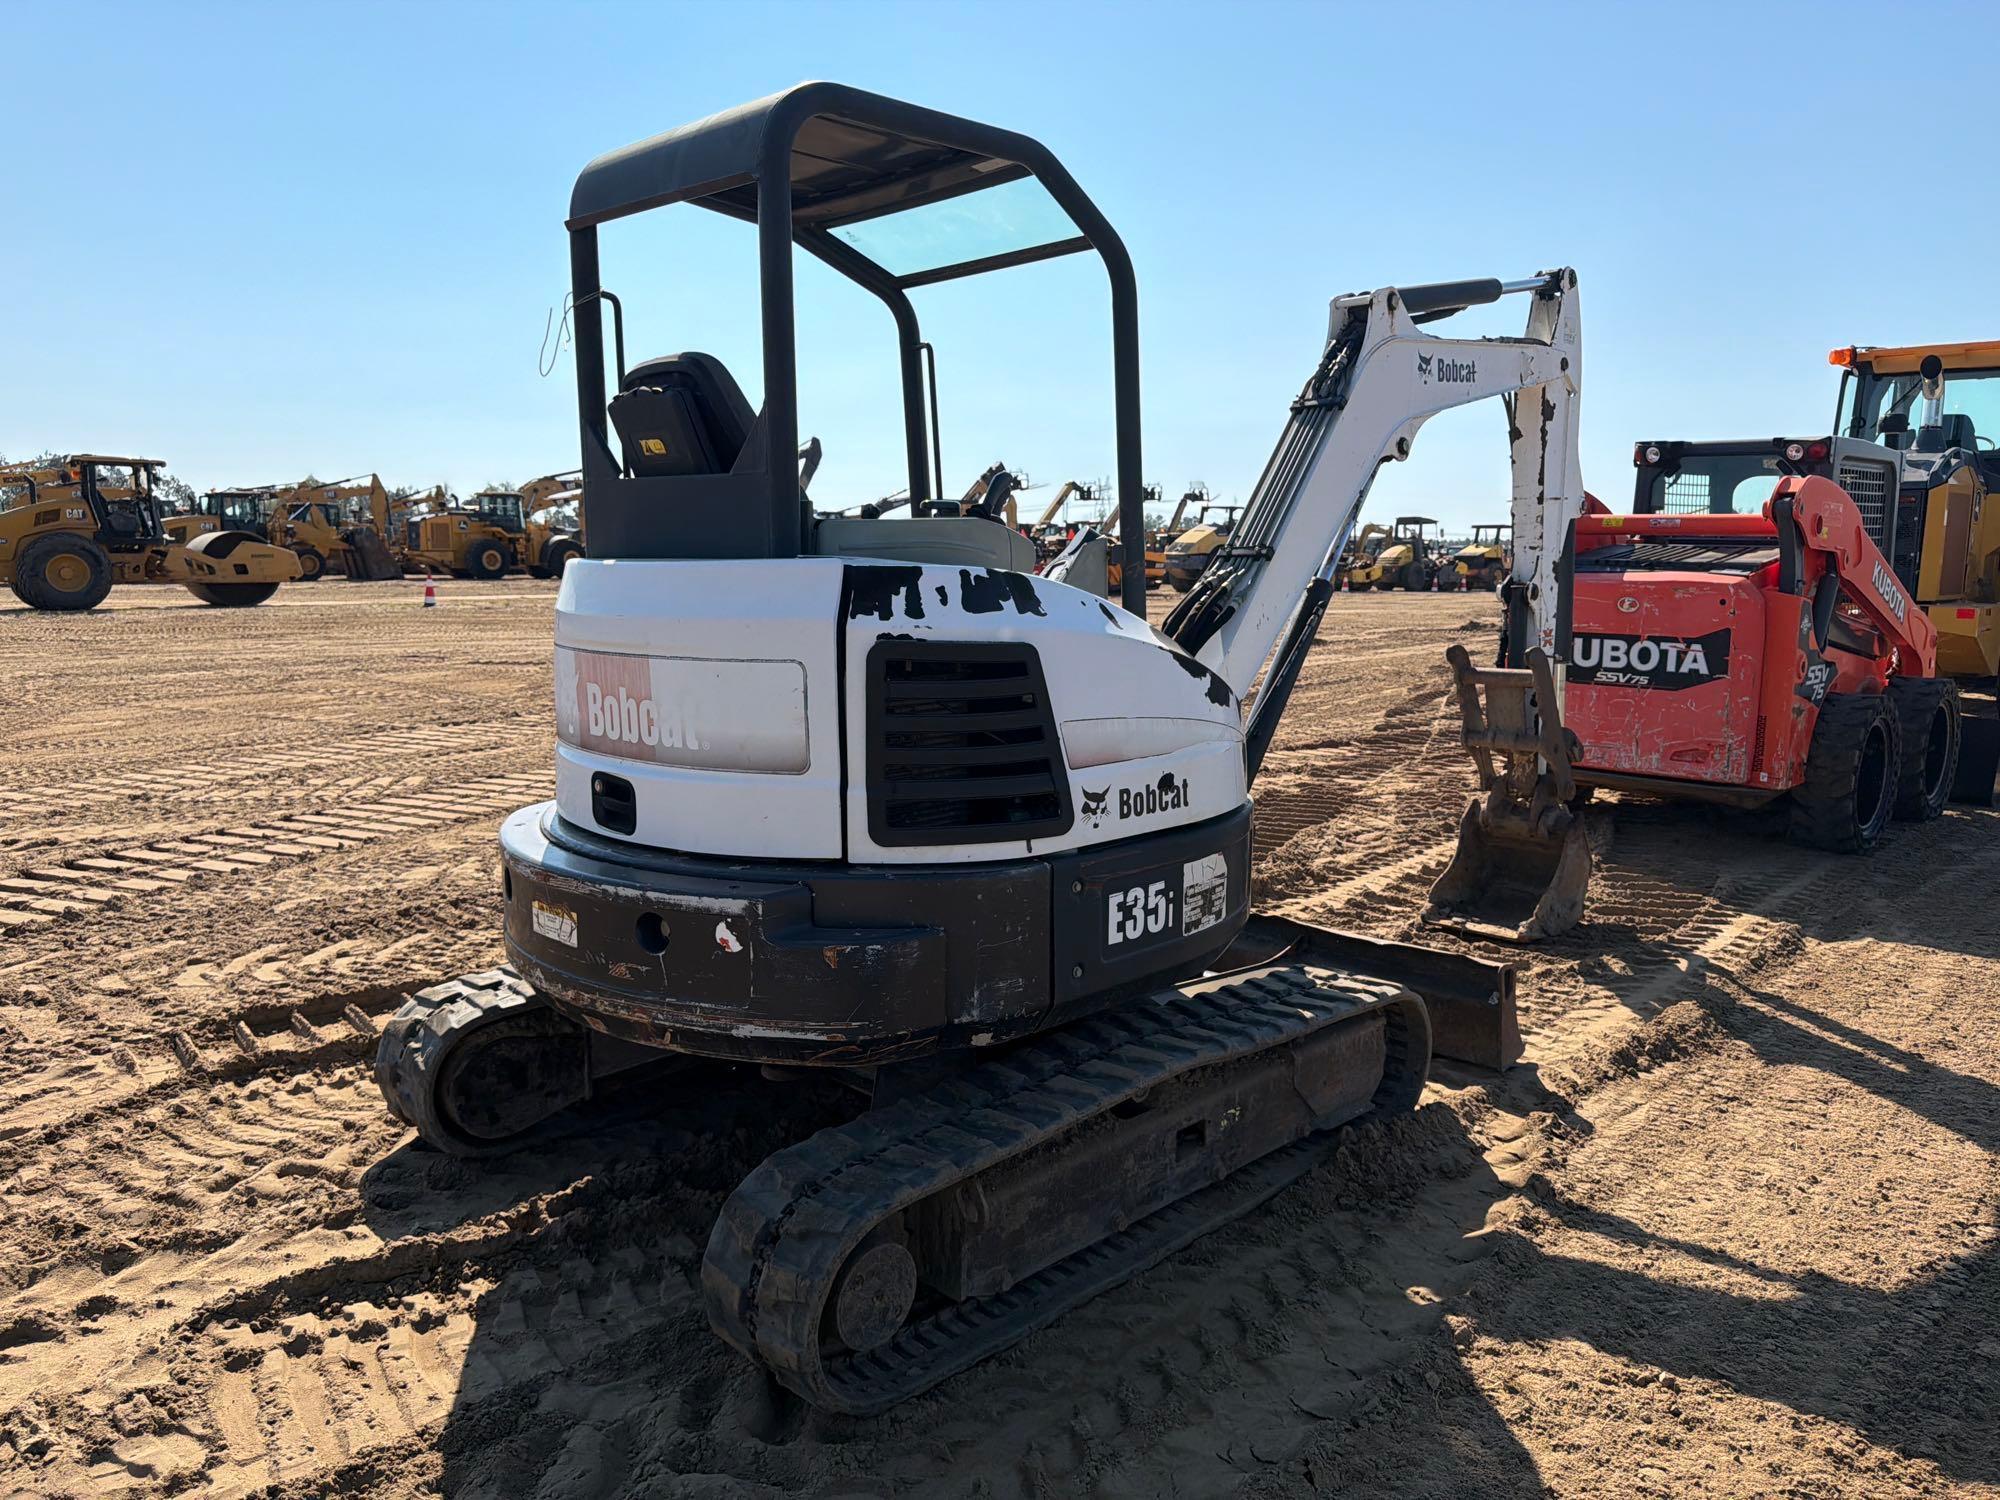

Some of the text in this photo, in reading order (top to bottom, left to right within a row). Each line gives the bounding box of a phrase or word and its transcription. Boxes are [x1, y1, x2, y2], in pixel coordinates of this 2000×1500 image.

[1437, 357, 1477, 383] Bobcat
[71, 490, 82, 498] CA
[66, 508, 84, 519] CAT
[1872, 560, 1906, 624] KUBOTA
[1573, 637, 1710, 675] UBOTA
[1806, 664, 1830, 685] SSV
[1812, 683, 1825, 700] 75
[586, 682, 699, 751] Bobcat
[1118, 777, 1190, 820] Bobcat
[1107, 879, 1175, 946] E35i
